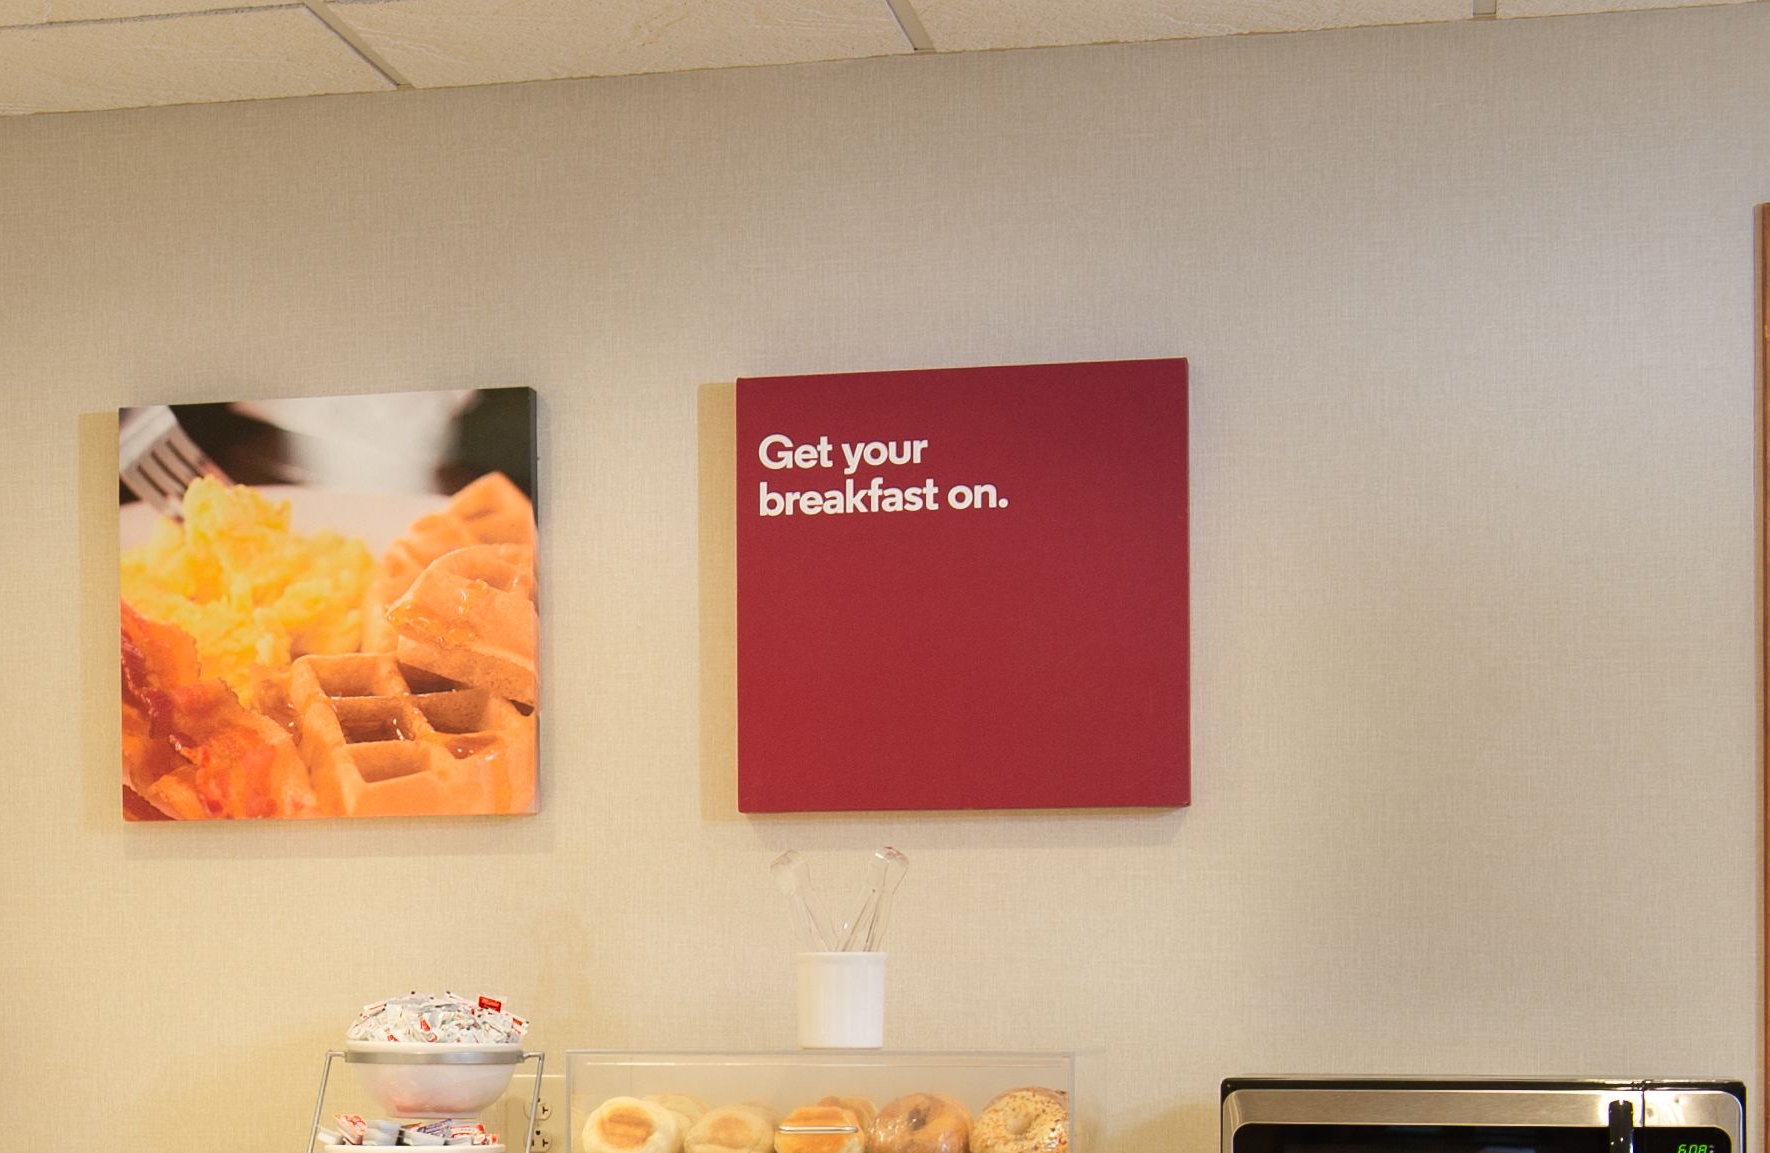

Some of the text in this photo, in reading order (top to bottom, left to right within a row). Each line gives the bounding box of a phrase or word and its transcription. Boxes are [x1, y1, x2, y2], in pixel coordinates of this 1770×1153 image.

[758, 433, 929, 475] Get your
[759, 477, 1009, 517] breakfast on.
